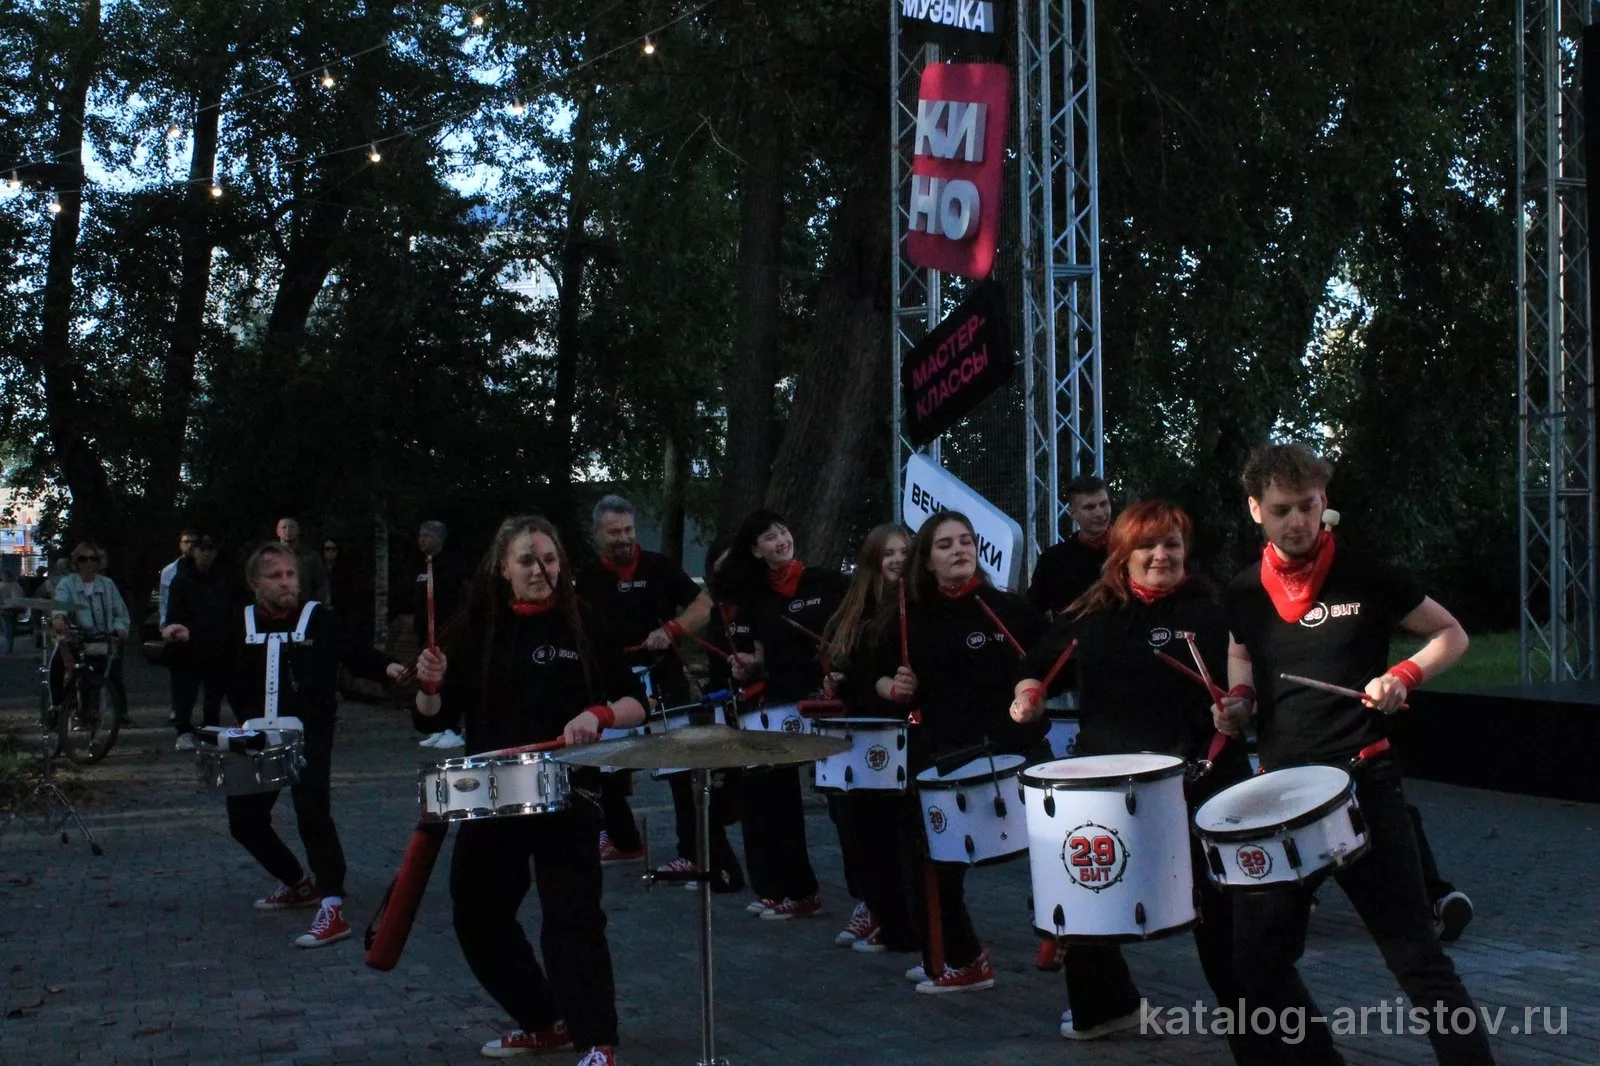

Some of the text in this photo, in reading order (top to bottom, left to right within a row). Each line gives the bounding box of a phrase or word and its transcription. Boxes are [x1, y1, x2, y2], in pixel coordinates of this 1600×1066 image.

[902, 0, 990, 32] МУЗЫКА
[914, 99, 986, 162] КИ
[909, 175, 980, 241] НО
[916, 343, 988, 423] КЛАССЫ
[1330, 602, 1361, 617] БИТ
[1069, 835, 1116, 867] 29
[1239, 850, 1266, 867] 29
[1079, 866, 1111, 882] БИТ
